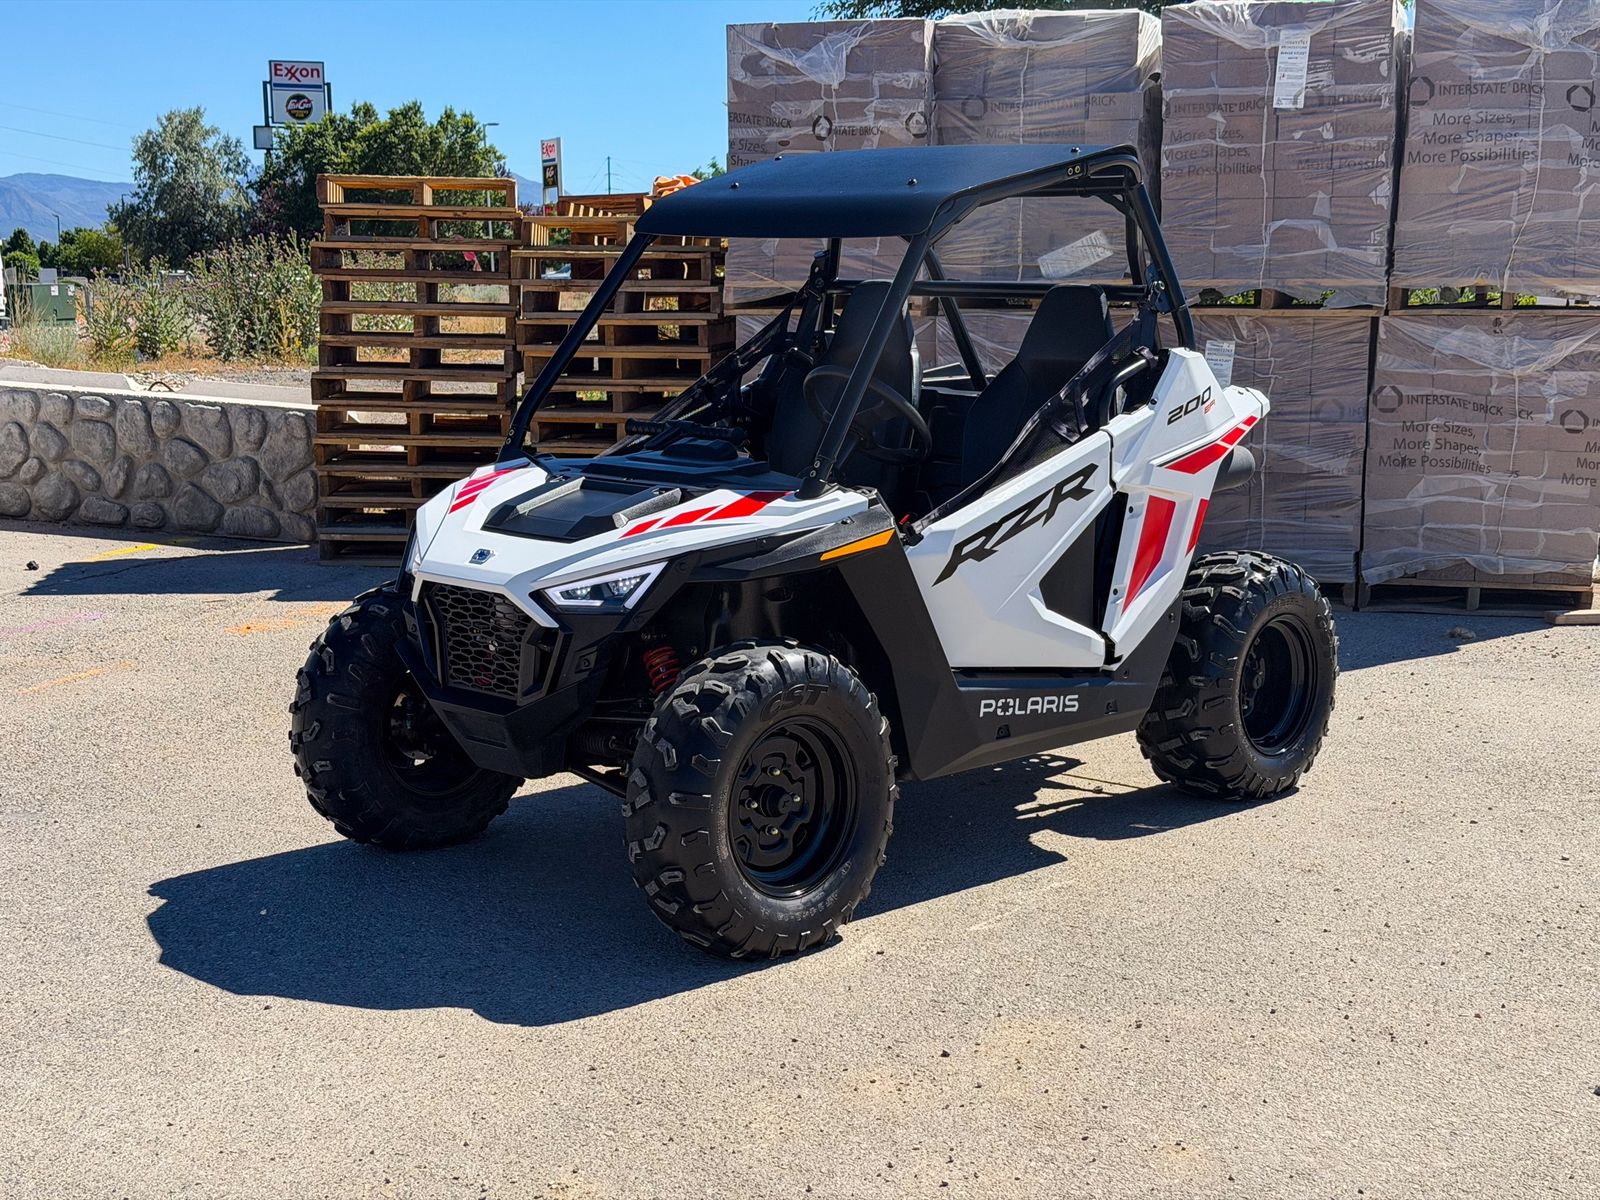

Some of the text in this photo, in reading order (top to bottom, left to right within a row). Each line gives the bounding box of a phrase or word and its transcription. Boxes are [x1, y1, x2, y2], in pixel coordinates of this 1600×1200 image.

[273, 63, 320, 82] Exxon
[1439, 82, 1509, 97] INTERSTATE
[1174, 102, 1238, 114] INTERSTATE
[766, 116, 792, 129] BRICK
[1433, 110, 1516, 126] More Sizes,
[1170, 129, 1205, 143] More
[1423, 132, 1463, 145] More
[1407, 147, 1538, 164] More Possibilities
[1167, 385, 1211, 426] 200
[1407, 394, 1504, 416] INTERSTATE BRICK
[1402, 420, 1476, 439] More Sizes,
[1393, 437, 1482, 457] More Shapes,
[1420, 455, 1492, 474] Possibilities
[1561, 472, 1597, 487] More
[931, 462, 1099, 588] RZR
[979, 694, 1079, 718] POLARIS
